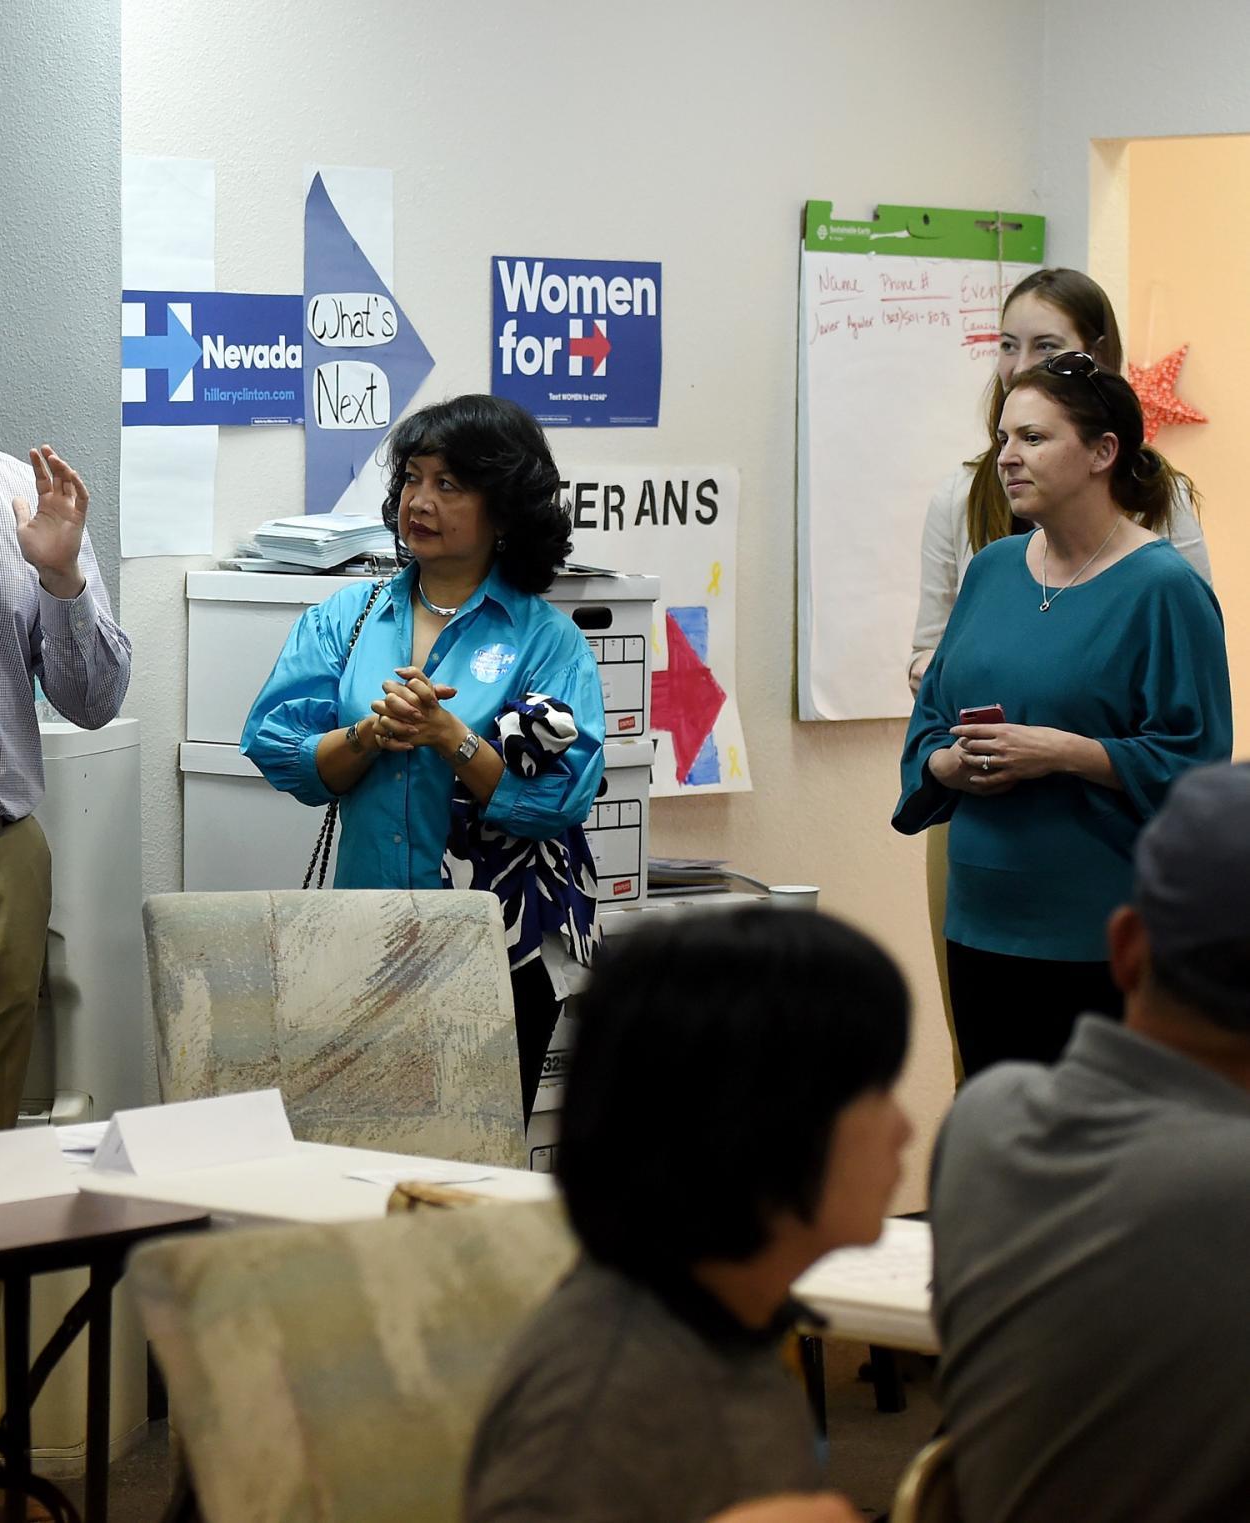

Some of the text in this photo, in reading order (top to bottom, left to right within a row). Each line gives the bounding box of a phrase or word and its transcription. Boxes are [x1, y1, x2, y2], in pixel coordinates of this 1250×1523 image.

[497, 260, 657, 316] Women
[818, 266, 865, 293] Name
[310, 297, 395, 340] What's
[202, 334, 303, 370] Nevada
[499, 319, 562, 376] for
[203, 387, 296, 405] hillaryclinton.com
[315, 363, 388, 426] Next
[548, 392, 561, 401] Text
[561, 393, 582, 401] WOMEN
[553, 478, 719, 532] TERANS
